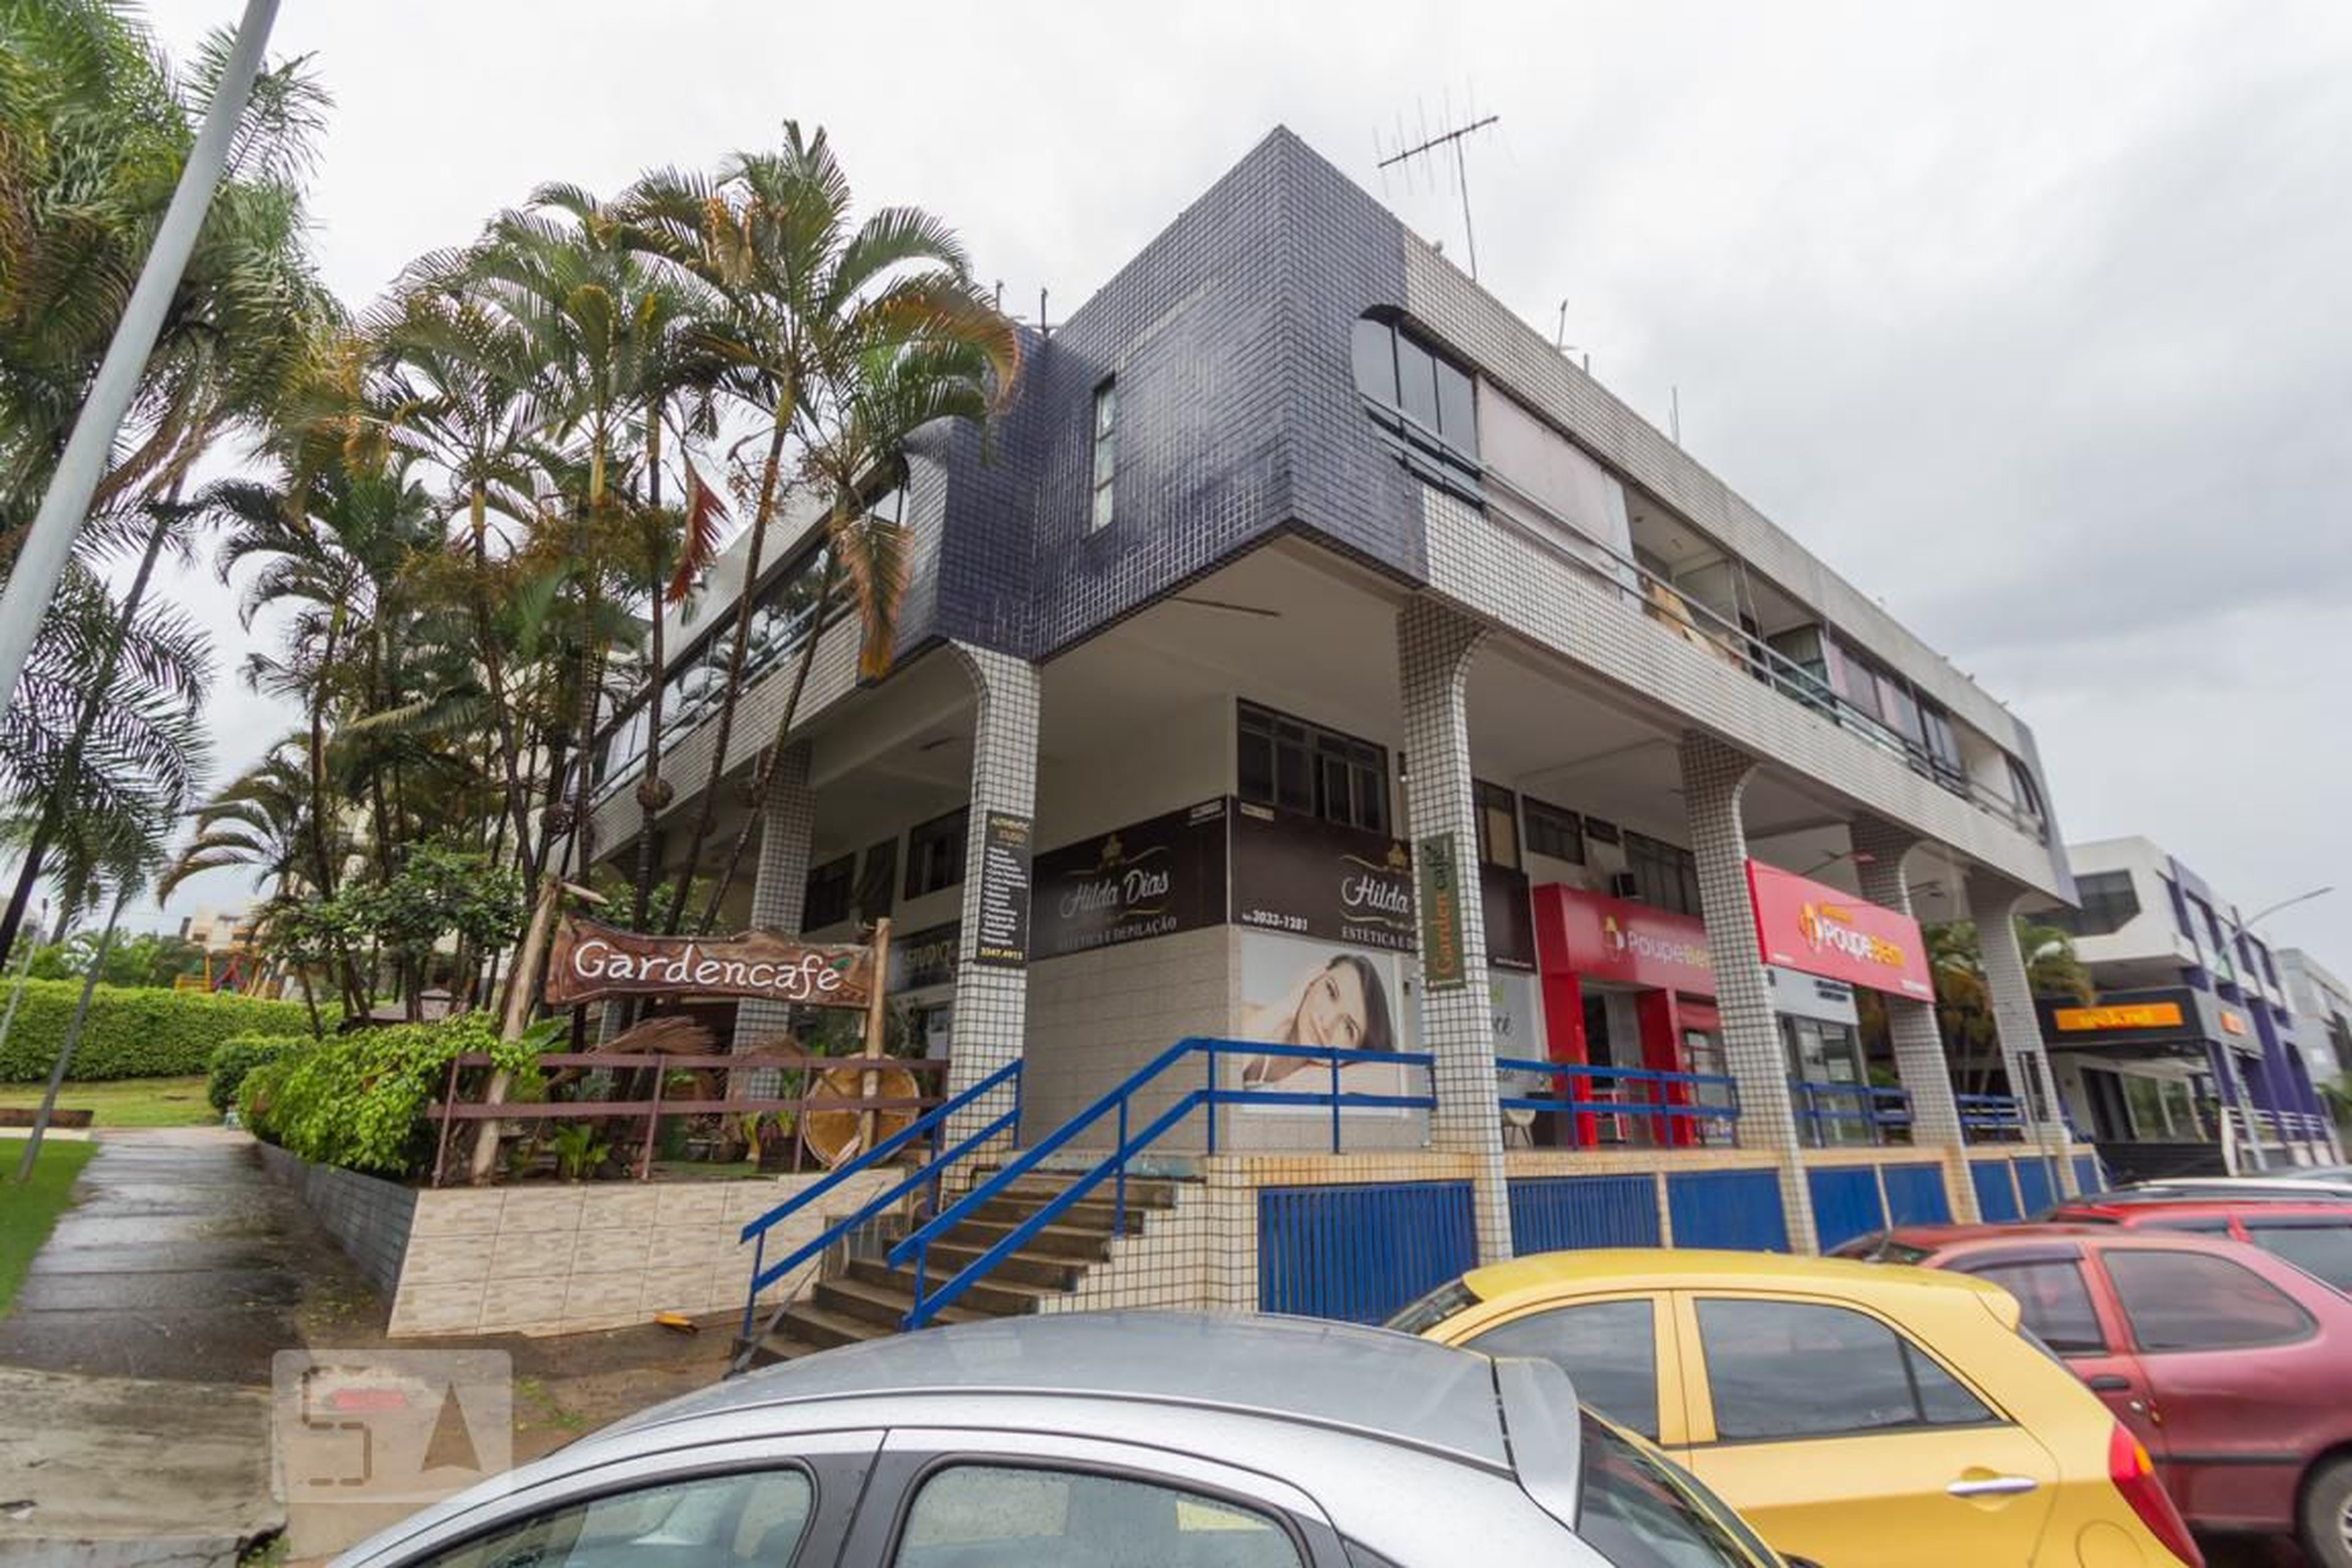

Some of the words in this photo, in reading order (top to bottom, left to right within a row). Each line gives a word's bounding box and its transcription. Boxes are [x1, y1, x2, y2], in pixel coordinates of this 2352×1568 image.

[1060, 878, 1119, 918] Hilda
[1123, 869, 1169, 905] Dias
[1341, 875, 1409, 913] Hilda
